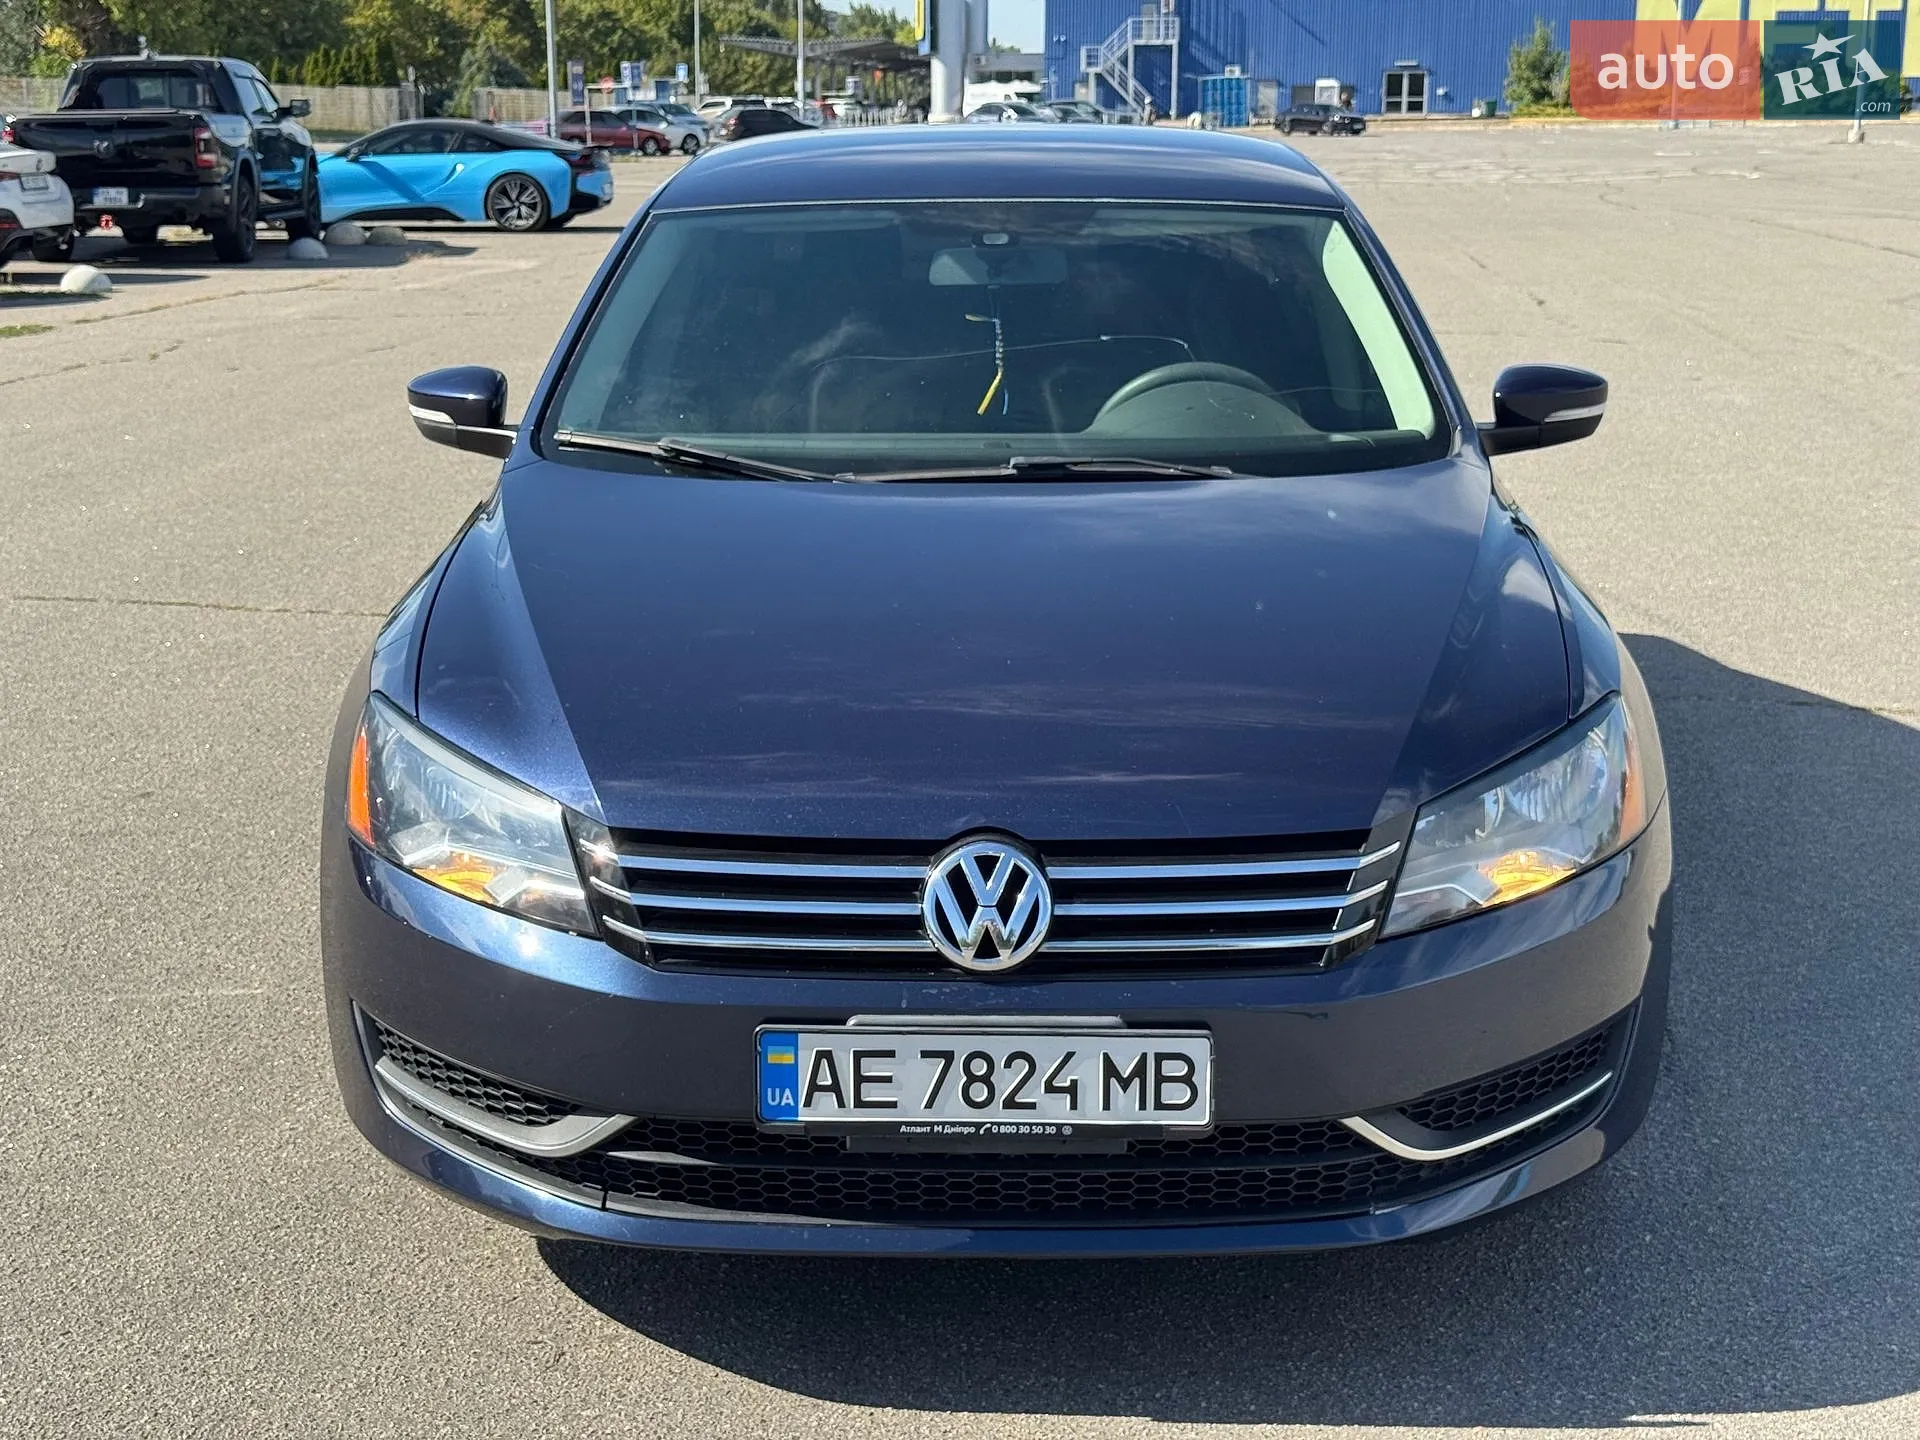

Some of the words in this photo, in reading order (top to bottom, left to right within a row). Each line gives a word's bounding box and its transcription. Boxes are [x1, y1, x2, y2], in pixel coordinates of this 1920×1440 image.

[1635, 0, 1920, 80] MET
[767, 1088, 794, 1106] UA
[801, 1048, 898, 1109] AE
[918, 1049, 1078, 1111] 7824
[1099, 1050, 1199, 1111] MB
[1000, 1125, 1016, 1134] 800
[1018, 1126, 1029, 1134] 30
[1031, 1126, 1043, 1134] 50
[1044, 1126, 1056, 1134] 30
